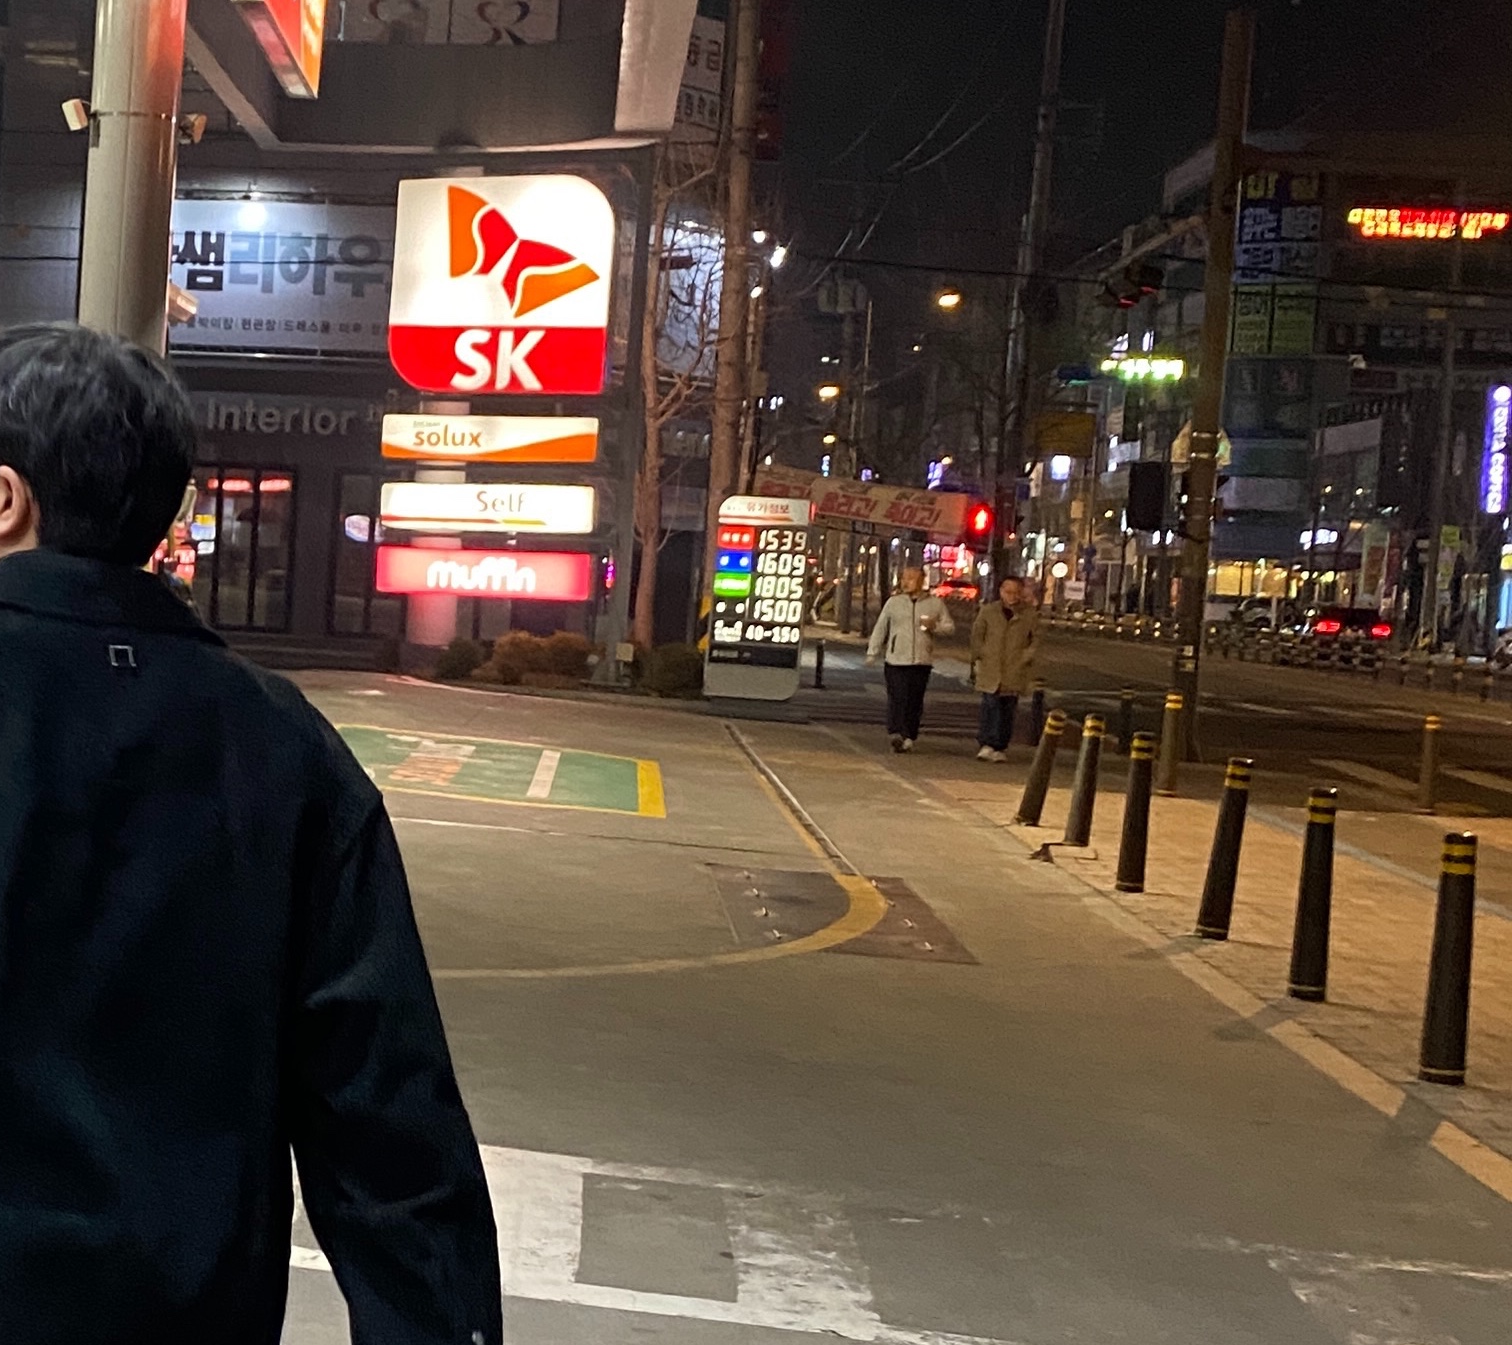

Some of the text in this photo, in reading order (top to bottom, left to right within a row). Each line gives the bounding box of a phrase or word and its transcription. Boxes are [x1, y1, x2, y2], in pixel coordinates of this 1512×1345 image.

[172, 228, 393, 298] 샘리하우
[450, 328, 547, 391] SK
[206, 397, 356, 436] Interior
[412, 424, 483, 448] solux
[475, 490, 526, 513] Self
[746, 501, 790, 514] 유가정보
[758, 529, 808, 552] 1539
[425, 556, 537, 593] muffin
[756, 552, 807, 576] 1609
[754, 575, 804, 600] 1805
[753, 598, 803, 624] 1500
